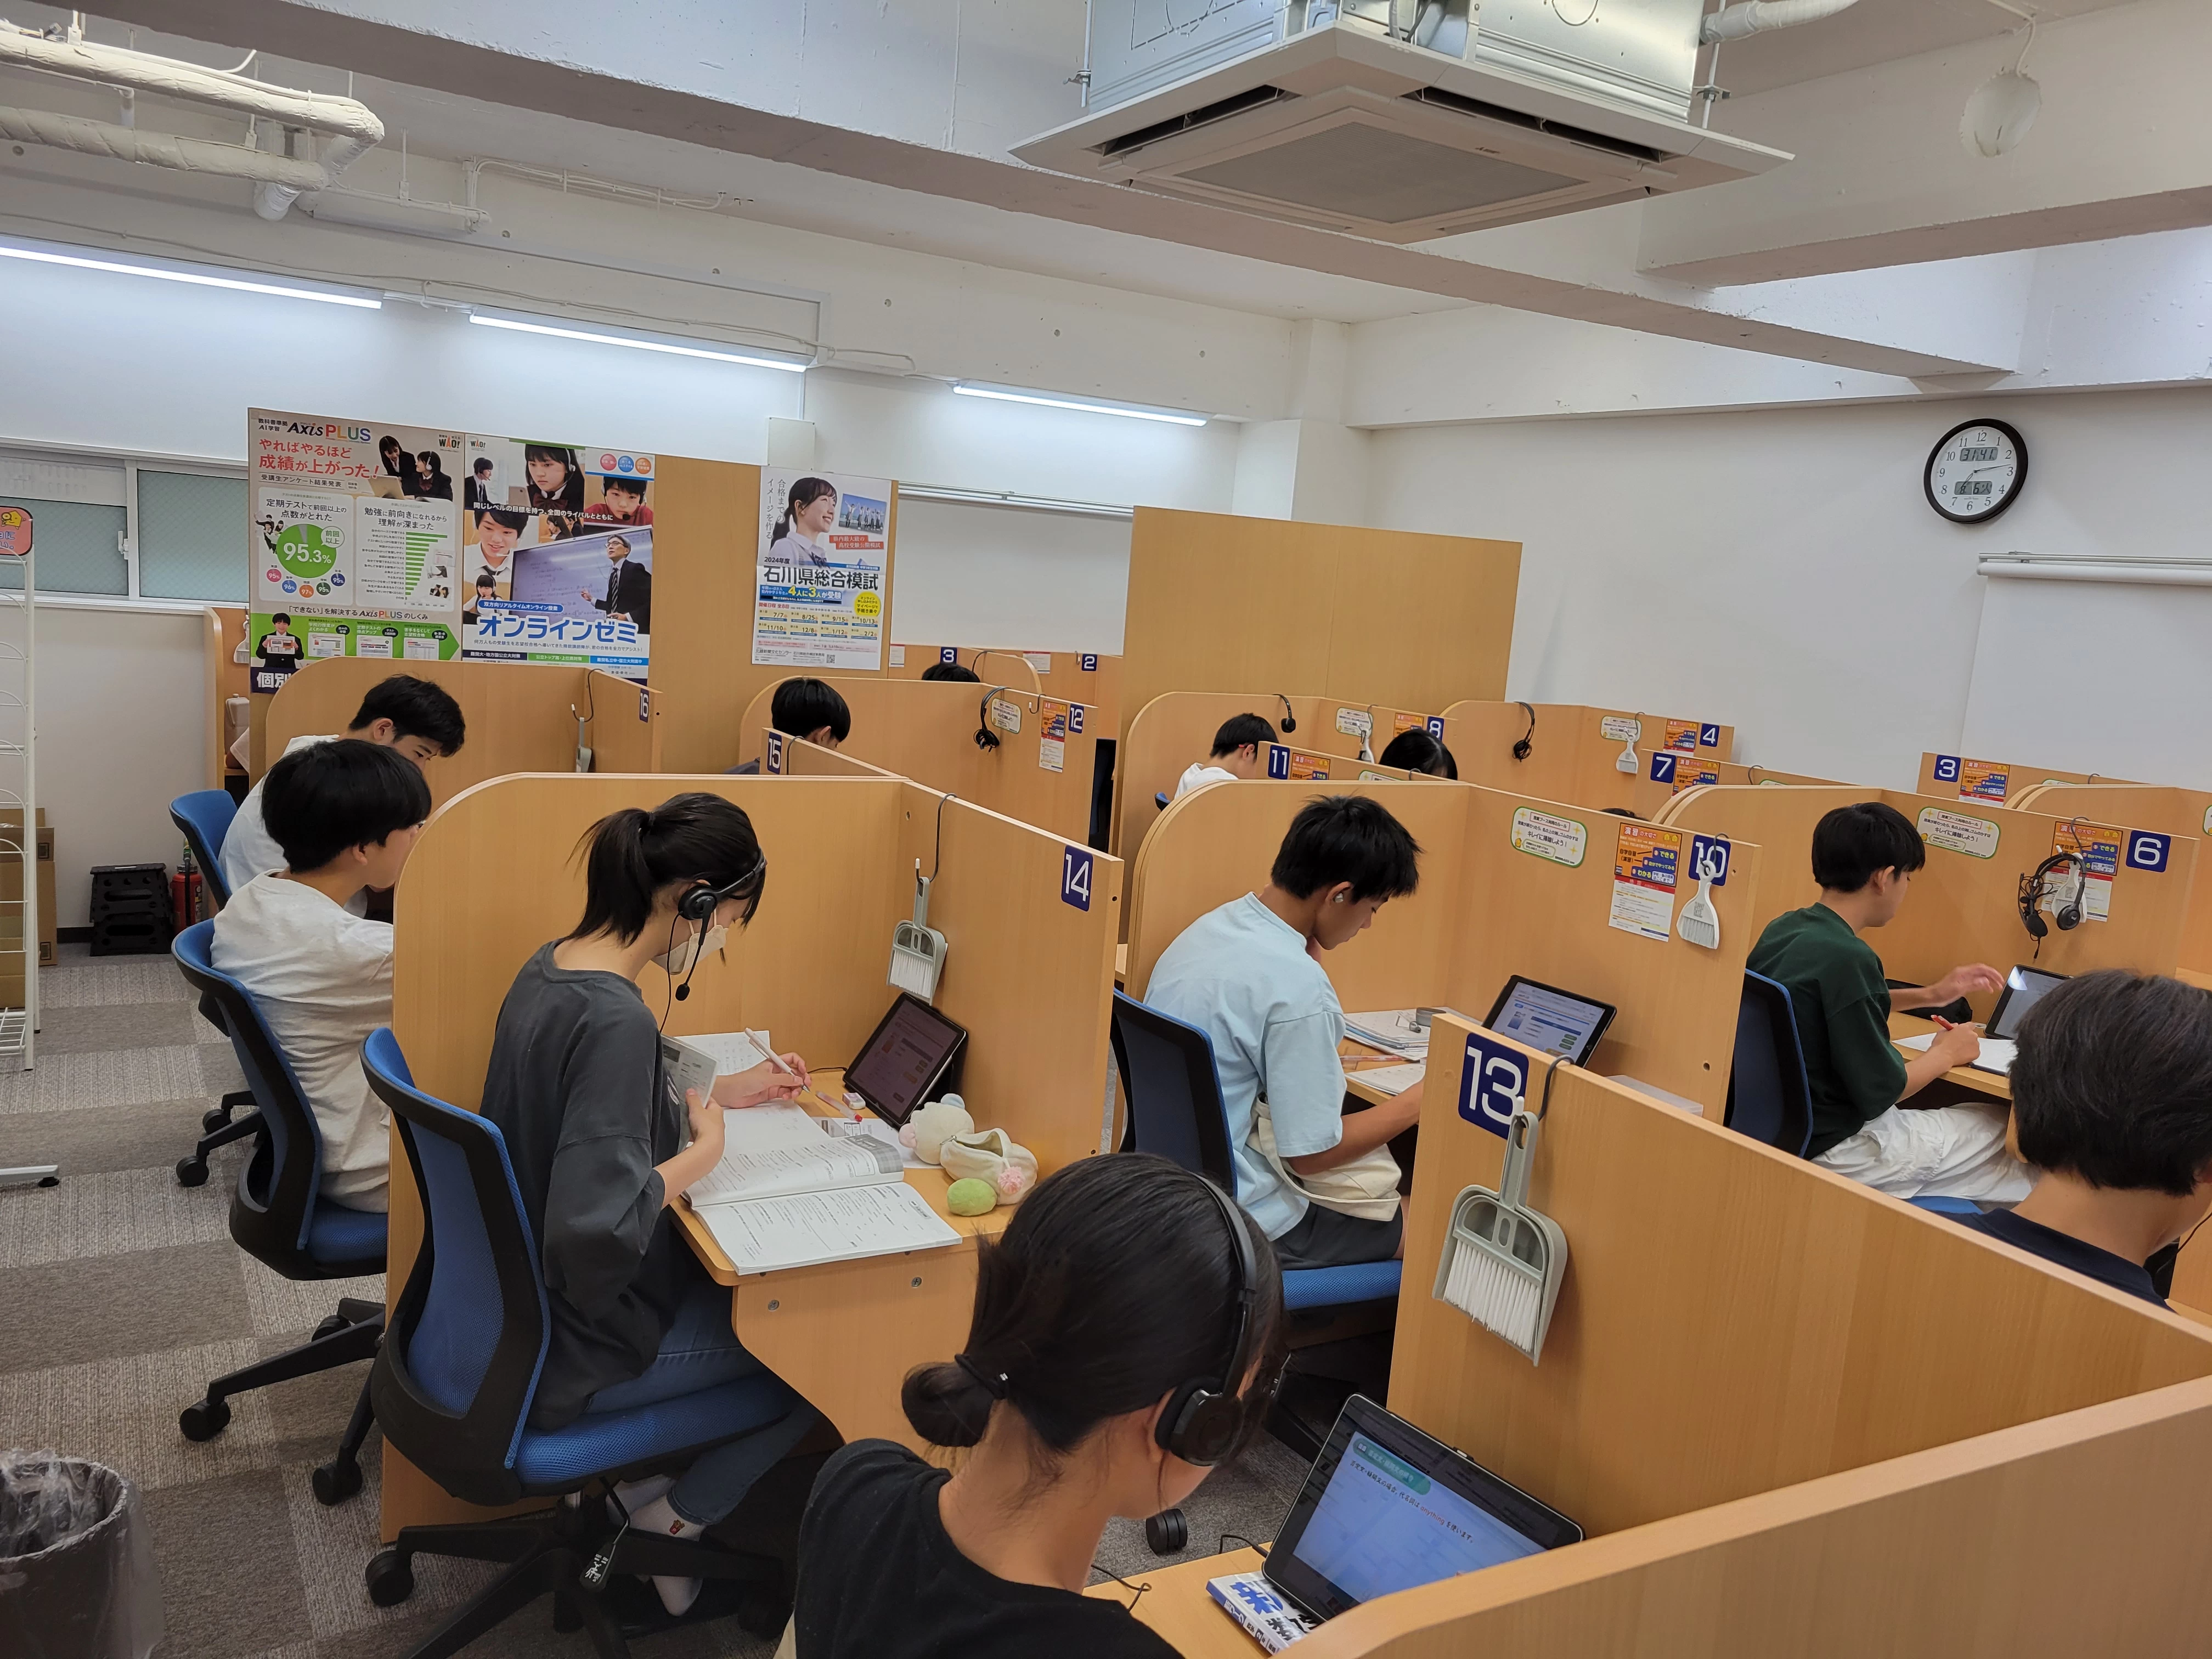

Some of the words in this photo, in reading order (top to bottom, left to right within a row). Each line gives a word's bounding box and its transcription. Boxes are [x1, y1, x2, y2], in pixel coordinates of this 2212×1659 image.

[286, 422, 324, 436] Axis
[325, 424, 371, 442] PLUS
[1976, 432, 1987, 442] 12
[439, 436, 460, 448] WAO!
[471, 439, 486, 448] WAO!
[1959, 437, 1967, 447] 11
[1996, 436, 2001, 446] 1
[259, 438, 352, 459] やればやるほど
[2005, 449, 2012, 459] 2
[1946, 452, 1956, 461] 10
[259, 454, 379, 479] 成績が上がった!
[1939, 468, 1945, 477] 9
[2006, 466, 2013, 477] 3
[261, 474, 342, 488] 受講生アンケート結果発表
[1941, 485, 1948, 494] 8
[1973, 483, 1980, 494] 6
[1999, 484, 2005, 494] 4
[266, 499, 347, 513] 定期テストで前回以上の
[777, 479, 786, 523] 合格までの
[1951, 496, 1958, 506] 7
[1967, 501, 1973, 511] 6
[1984, 496, 1991, 506] 5
[281, 510, 332, 522] 点数がとれた
[364, 507, 447, 522] 勉強に前向きになれるから
[473, 502, 613, 521] 同じレベルの目標を持つ、全国のライバルとともに
[378, 518, 434, 531] 理解が深まった
[284, 543, 331, 563] 95.3%
[764, 565, 879, 591] 石川県総合模試
[788, 585, 842, 600] 4人に3人が受験
[289, 606, 358, 616] 「できない」を解決する
[484, 602, 558, 611] 双方向リアルタイムオンライン授業
[478, 616, 636, 644] オンラインゼミ
[943, 649, 955, 663] 3
[1084, 656, 1095, 669] 2
[640, 692, 648, 718] 16
[1070, 707, 1084, 730] 12
[1429, 720, 1441, 738] 8
[1702, 727, 1716, 744] 4
[769, 738, 781, 769] 15
[1272, 749, 1288, 775] 11
[1656, 756, 1672, 778] 7
[1938, 759, 1956, 778] 3
[1660, 851, 1674, 859] できる
[2134, 837, 2162, 865] 6
[1695, 841, 1726, 878] 10
[1065, 853, 1089, 902] 14
[1637, 870, 1651, 878] わかる
[1467, 1046, 1522, 1125] 13
[1420, 1506, 1444, 1526] anything
[1446, 1521, 1474, 1543] を使います。
